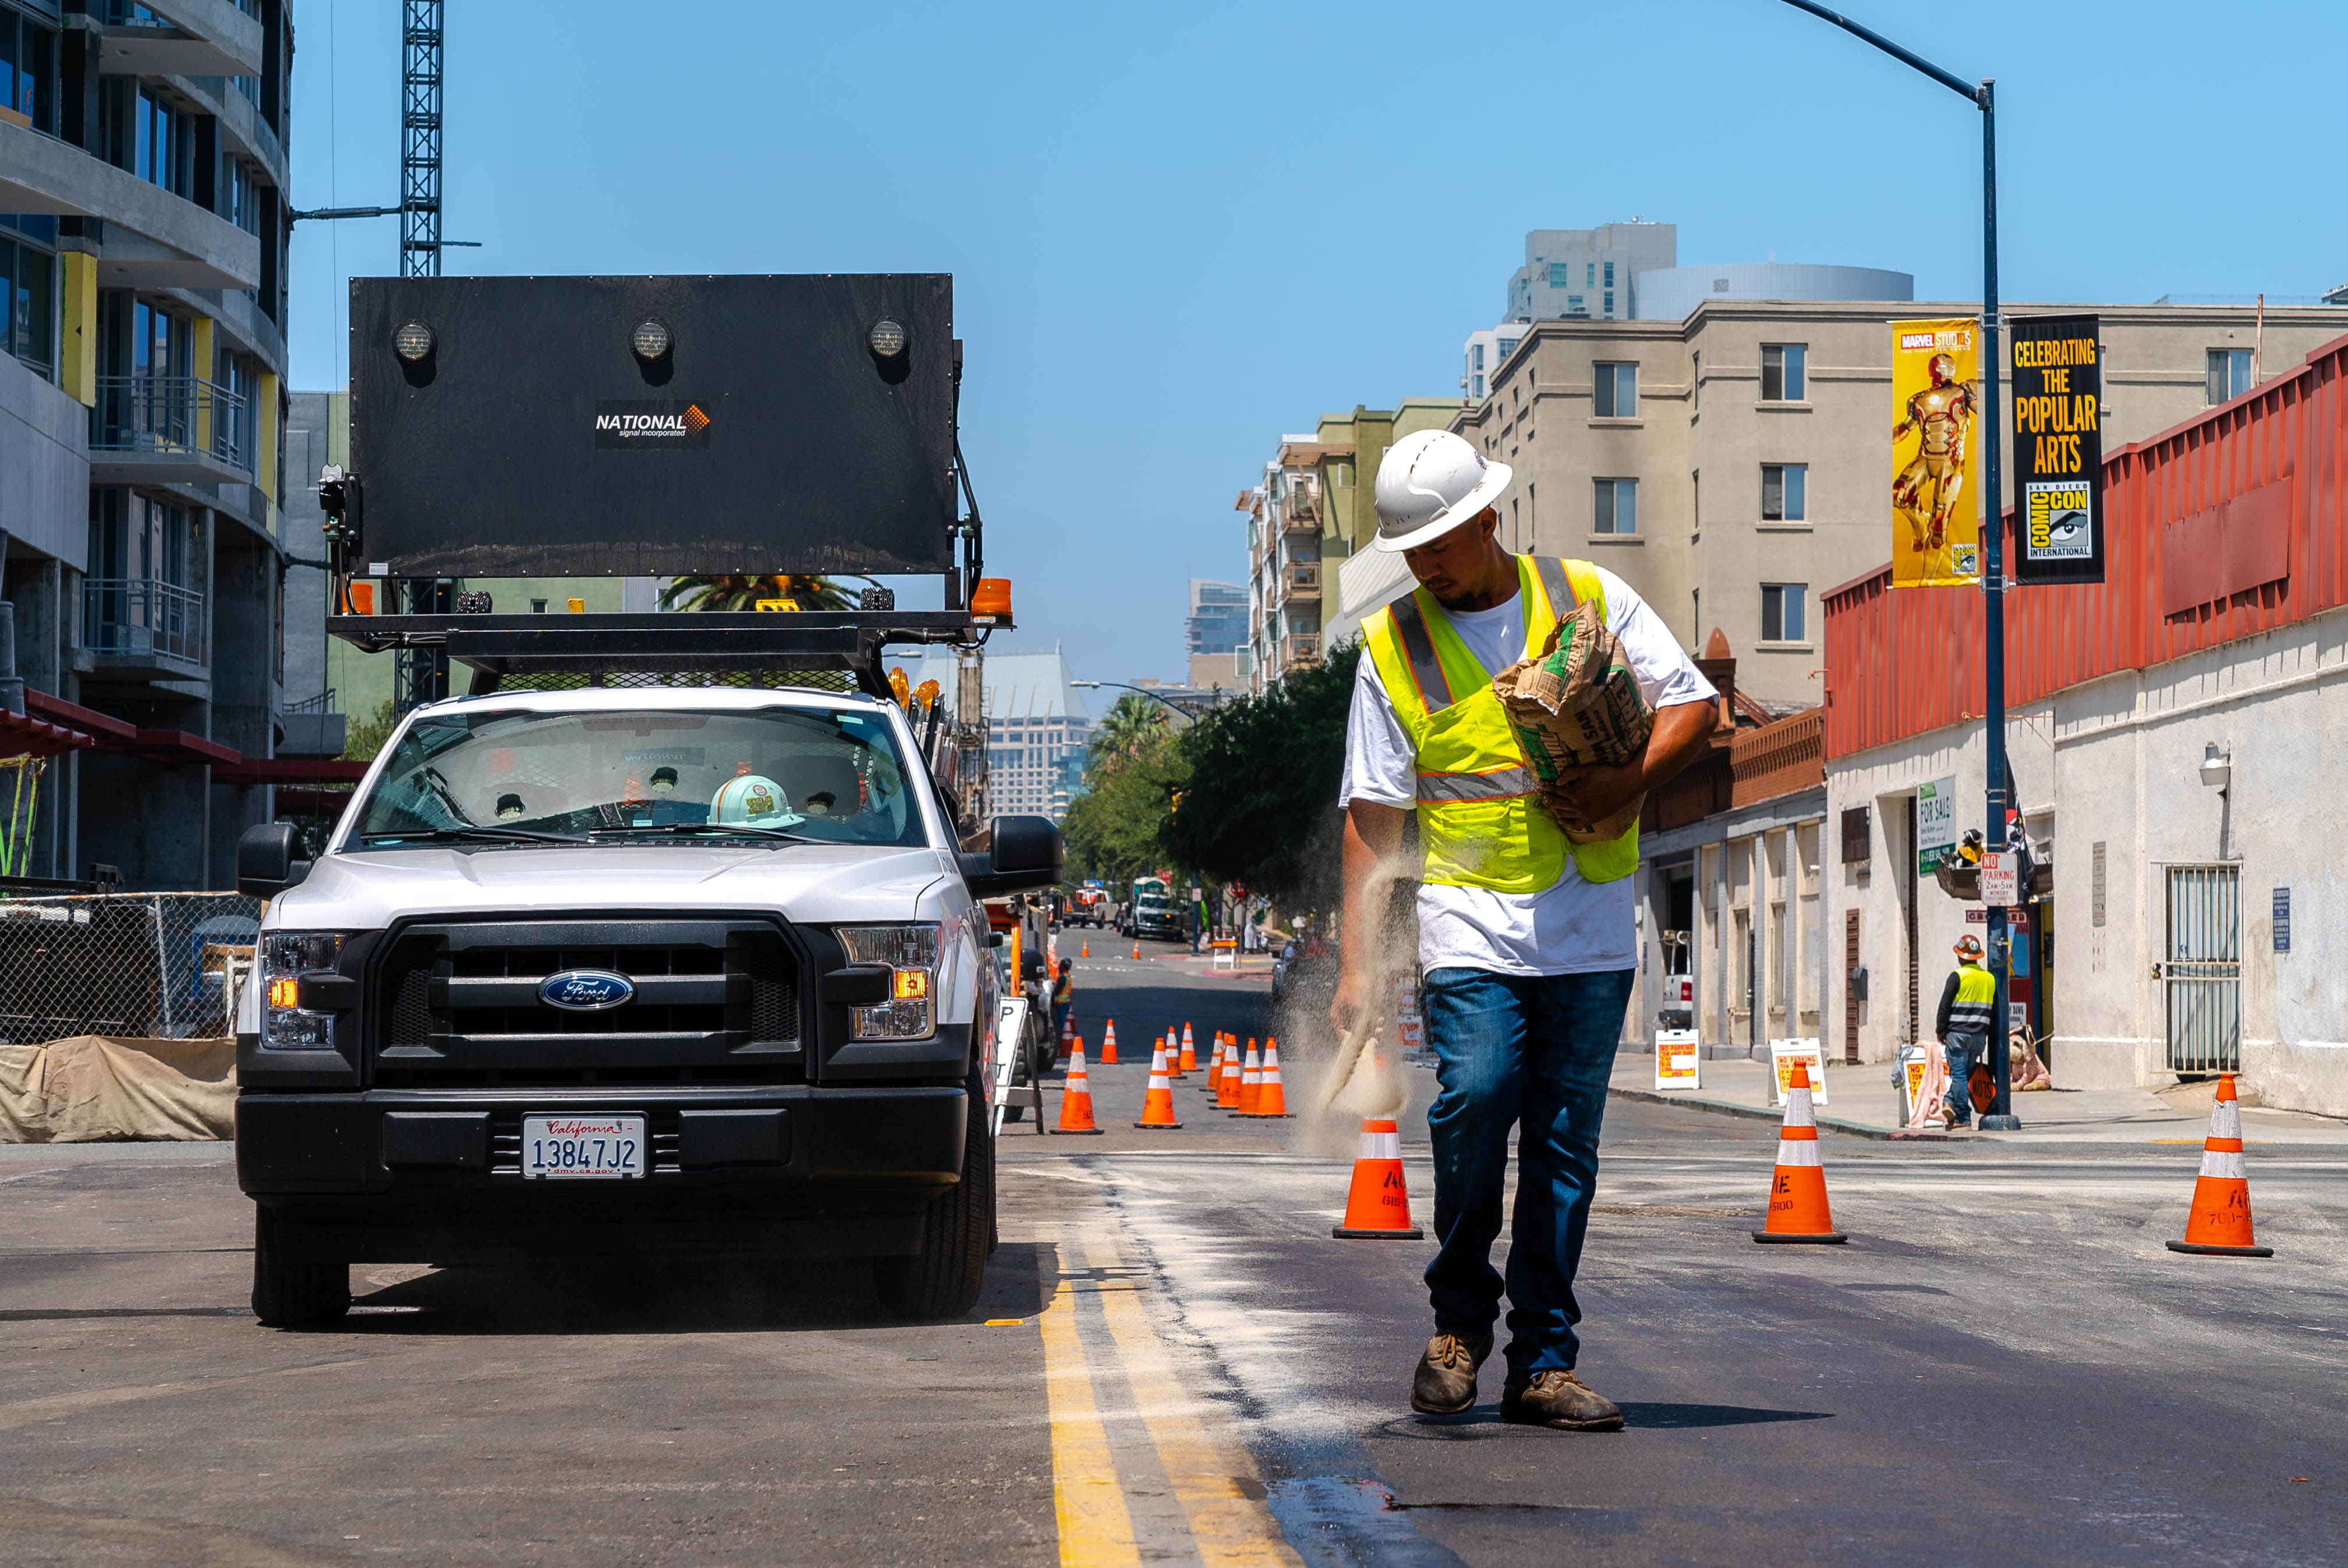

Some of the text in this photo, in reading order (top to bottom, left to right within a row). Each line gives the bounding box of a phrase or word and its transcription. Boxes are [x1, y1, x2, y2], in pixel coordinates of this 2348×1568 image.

[1901, 334, 1934, 348] MARVEL
[2014, 338, 2096, 368] CELEBRATING
[2042, 369, 2070, 393] THE
[596, 415, 687, 430] NATIONAL
[2016, 395, 2097, 433] POPULAR
[619, 430, 686, 438] signal incorporated
[2034, 434, 2081, 474] ARTS
[2050, 491, 2087, 510] CON
[2030, 492, 2050, 547] COMIC
[2030, 547, 2089, 557] INTERNATIONAL
[1921, 796, 1950, 824] FOR SALE
[1984, 856, 1997, 868] NO
[1984, 871, 2014, 880] PARKING
[561, 981, 610, 1001] Ford
[549, 1120, 621, 1138] California
[532, 1139, 635, 1169] 13847J2
